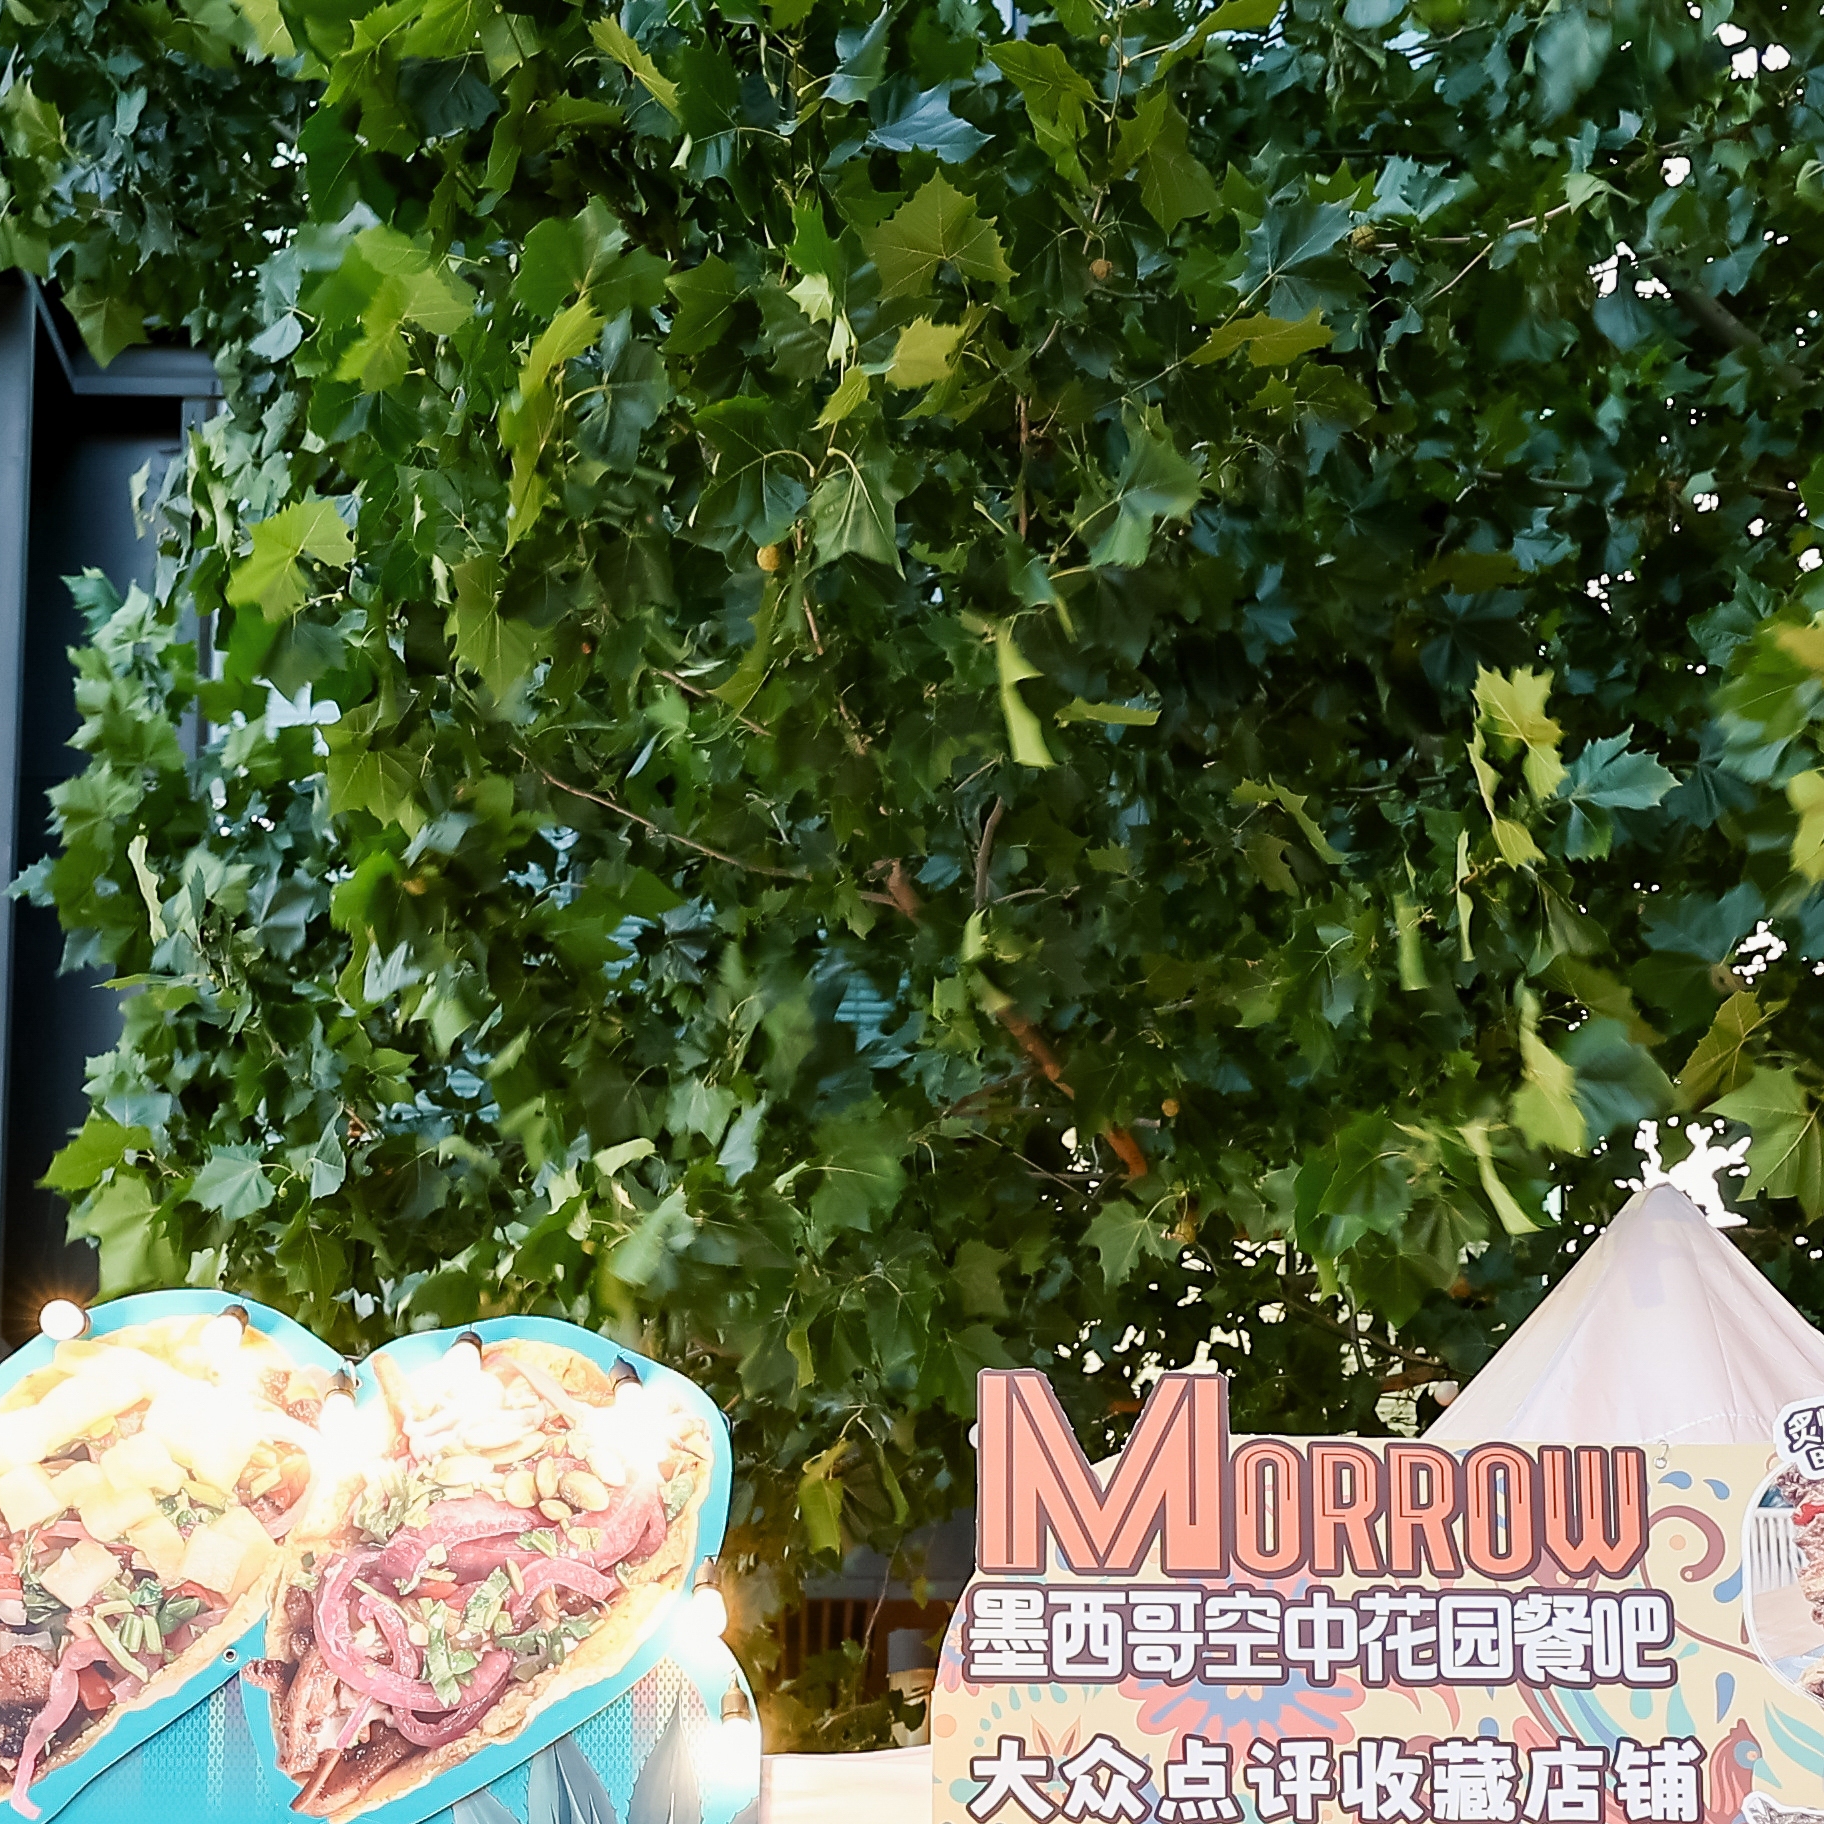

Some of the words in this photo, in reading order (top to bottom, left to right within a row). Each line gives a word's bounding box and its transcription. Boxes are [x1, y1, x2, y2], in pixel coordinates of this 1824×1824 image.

[978, 1372, 1650, 1577] MORROW
[969, 1591, 1677, 1682] 墨西哥空中花园餐吧
